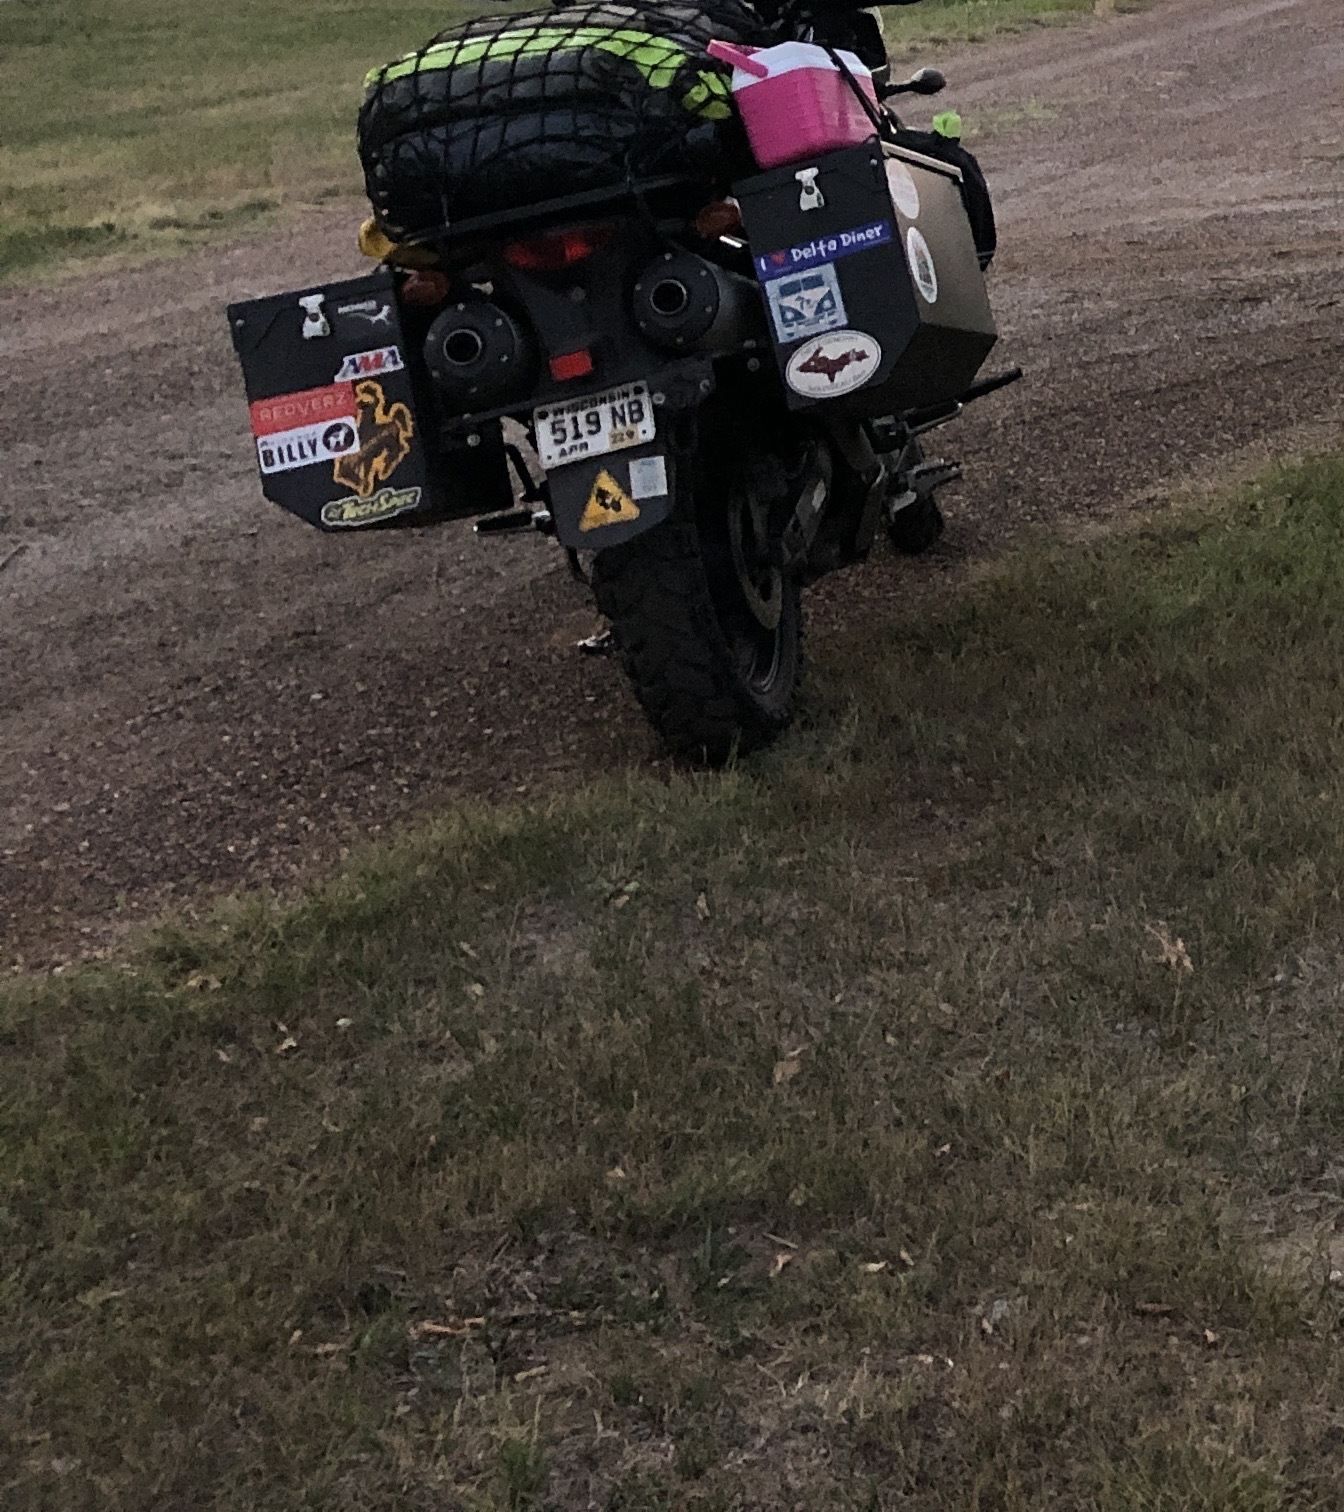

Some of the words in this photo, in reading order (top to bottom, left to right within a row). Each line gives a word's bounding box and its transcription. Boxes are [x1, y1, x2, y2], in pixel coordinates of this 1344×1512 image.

[790, 241, 837, 262] Delta
[840, 224, 883, 247] Diner
[341, 348, 399, 378] AMA
[550, 410, 602, 446] 519
[610, 399, 645, 429] NB
[262, 438, 318, 468] BILLY
